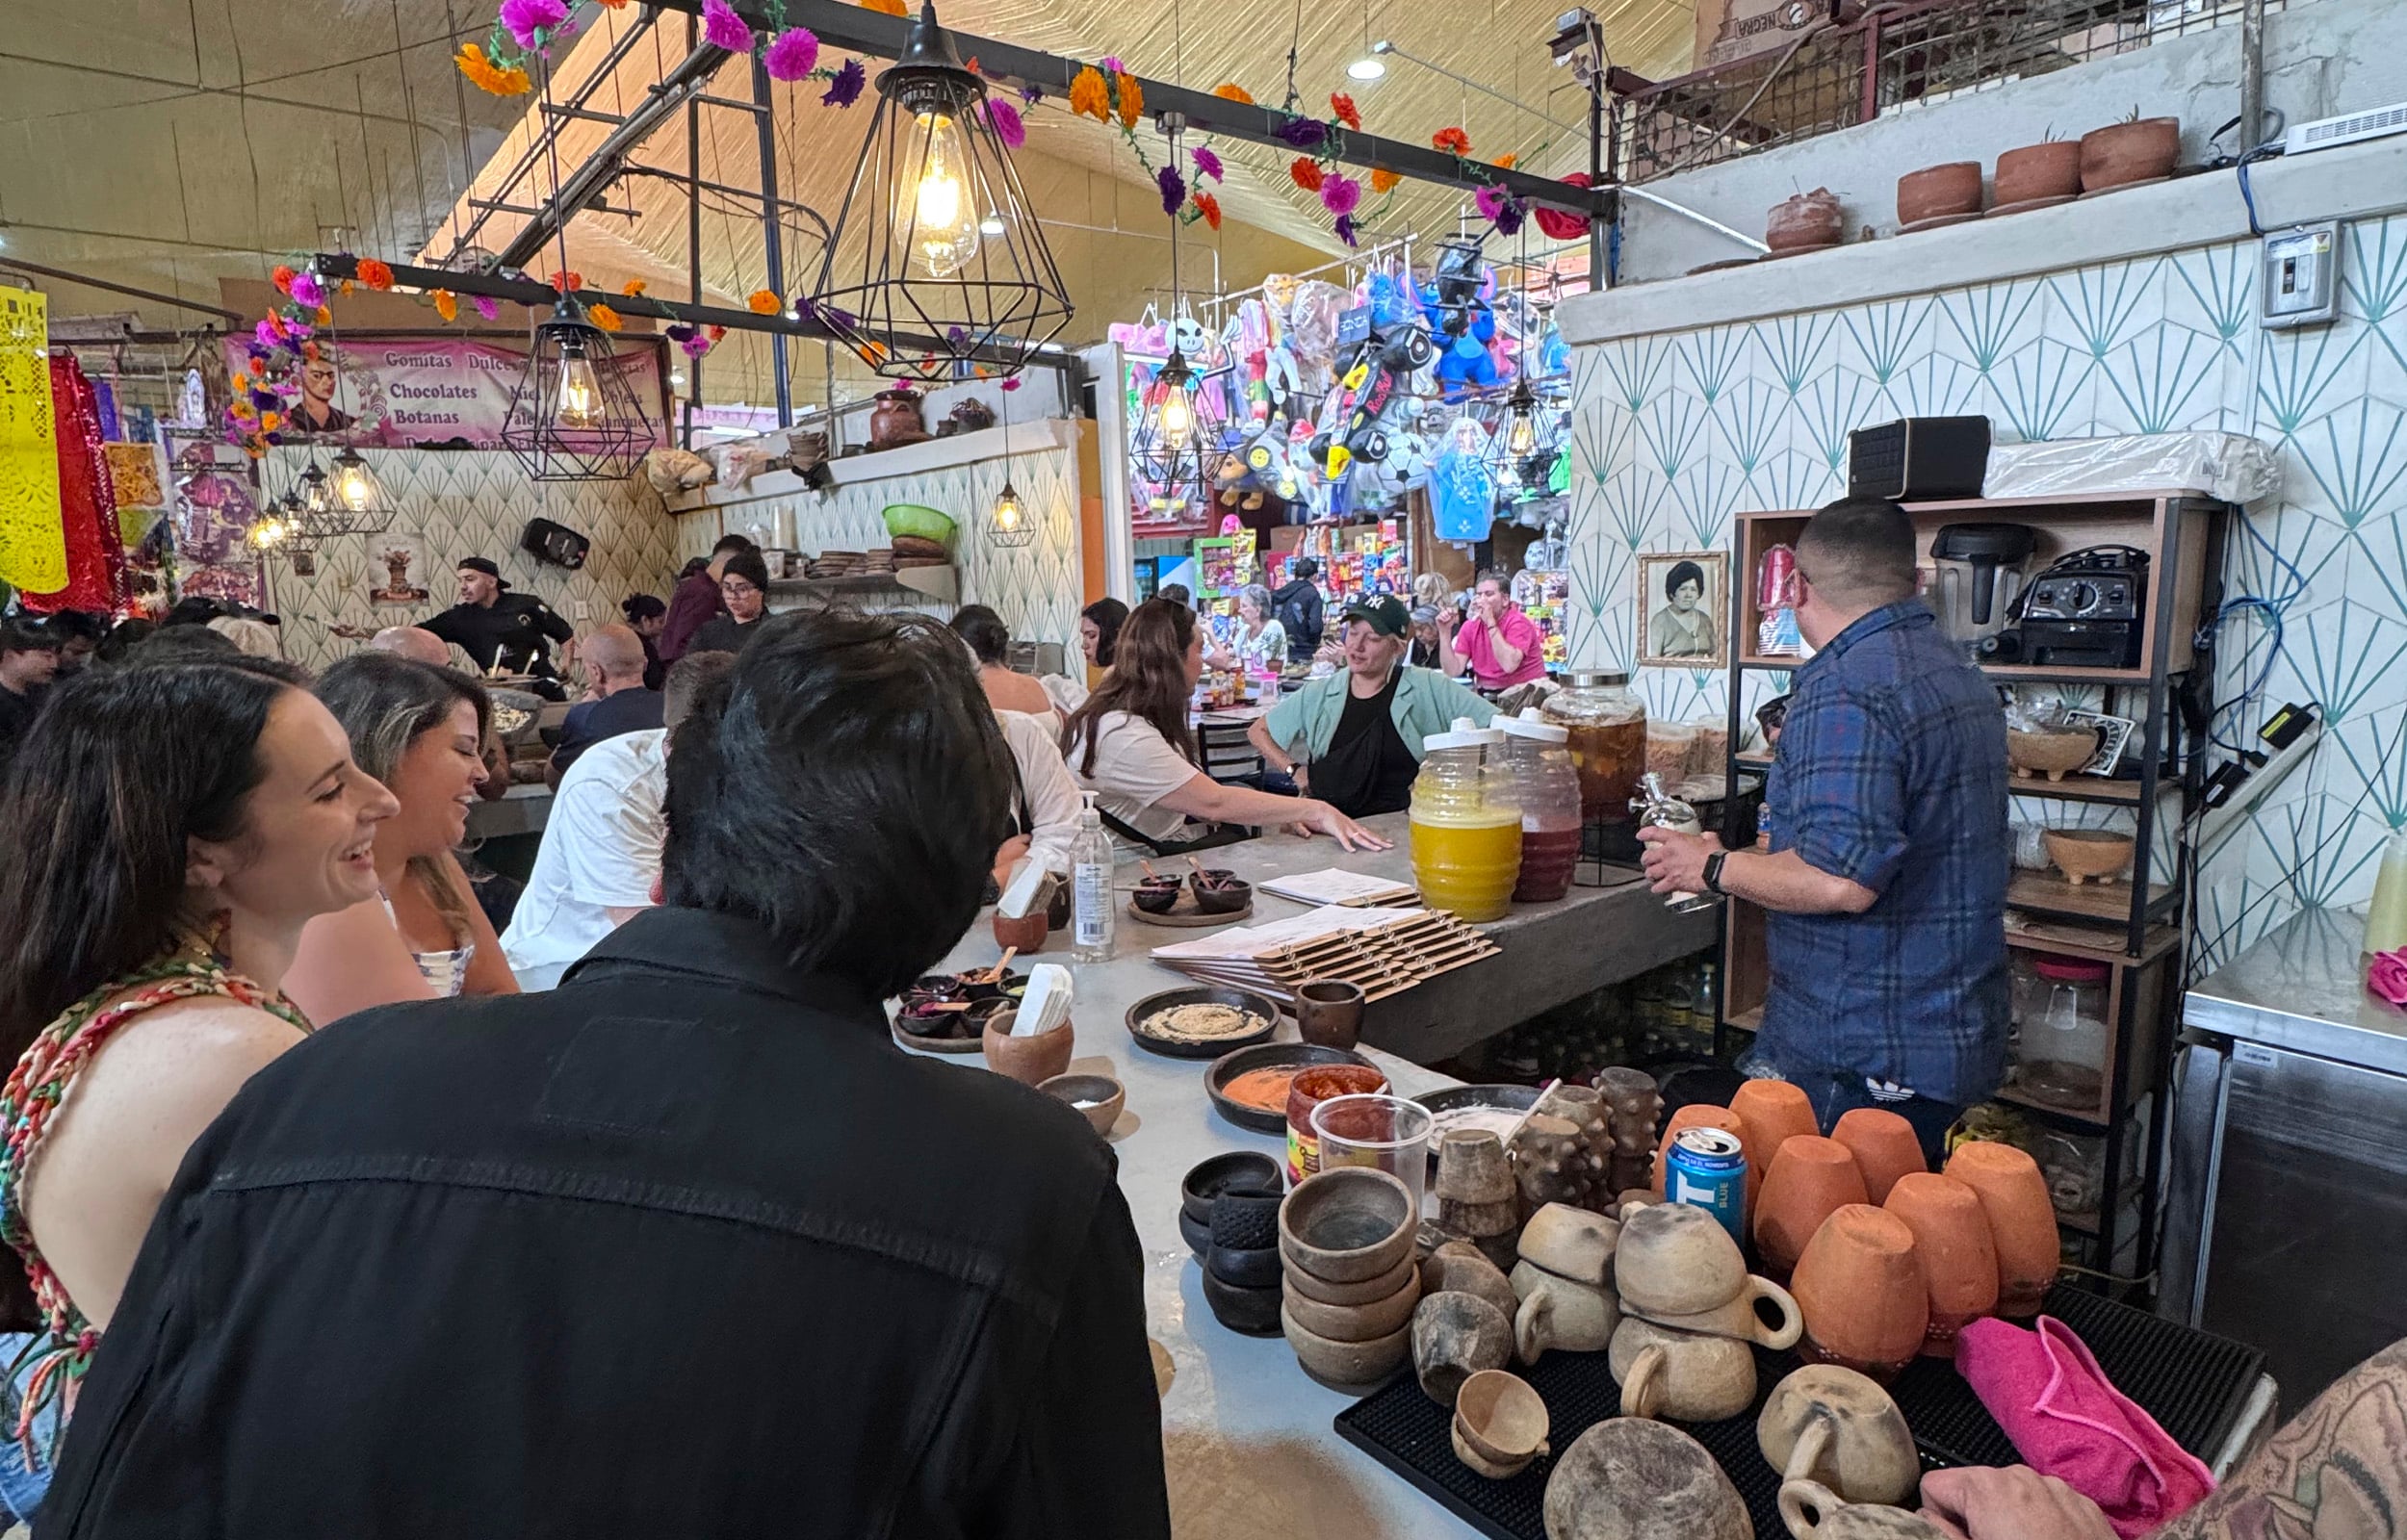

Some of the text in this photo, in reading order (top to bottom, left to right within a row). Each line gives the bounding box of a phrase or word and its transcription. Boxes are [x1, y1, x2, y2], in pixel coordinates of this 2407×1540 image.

[1738, 13, 1776, 37] NEGRA
[385, 352, 453, 367] Gomitas
[389, 383, 478, 398] Chocolates
[394, 409, 459, 424] Botanas
[1719, 1182, 1729, 1209] BLUE
